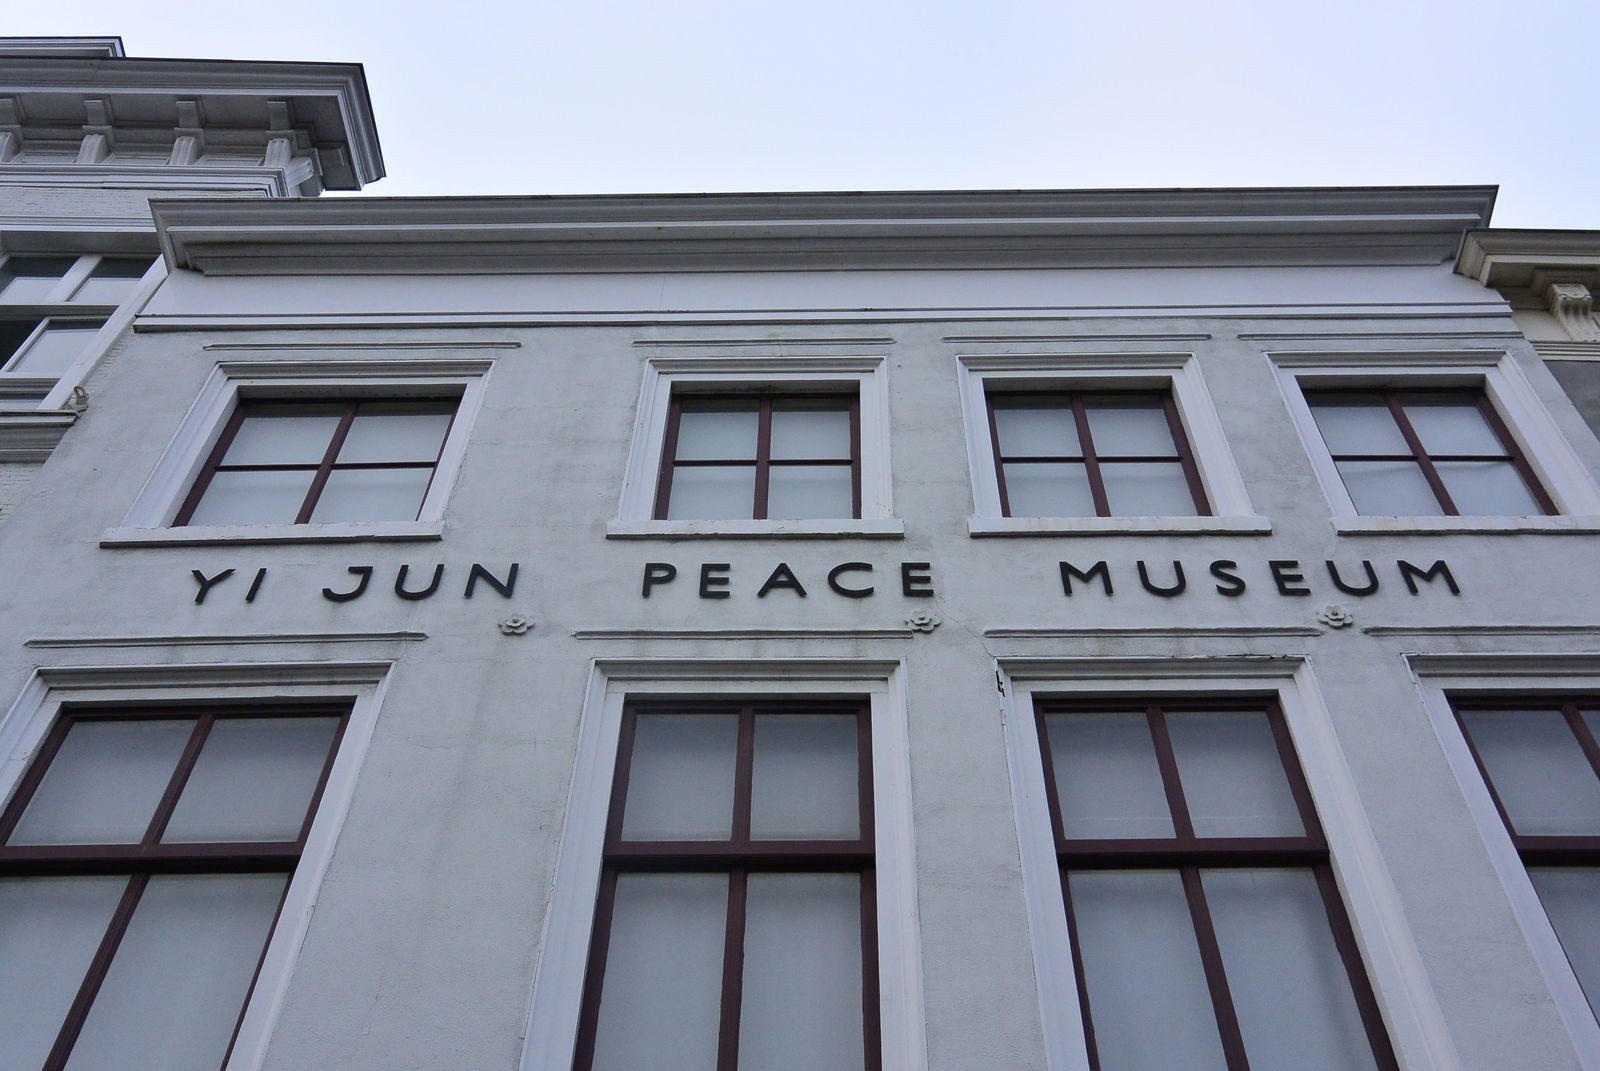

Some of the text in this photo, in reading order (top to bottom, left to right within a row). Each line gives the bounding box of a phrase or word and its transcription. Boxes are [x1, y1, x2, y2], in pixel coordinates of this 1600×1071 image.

[191, 559, 1461, 605] YI JUN PEACE MUSEUM
